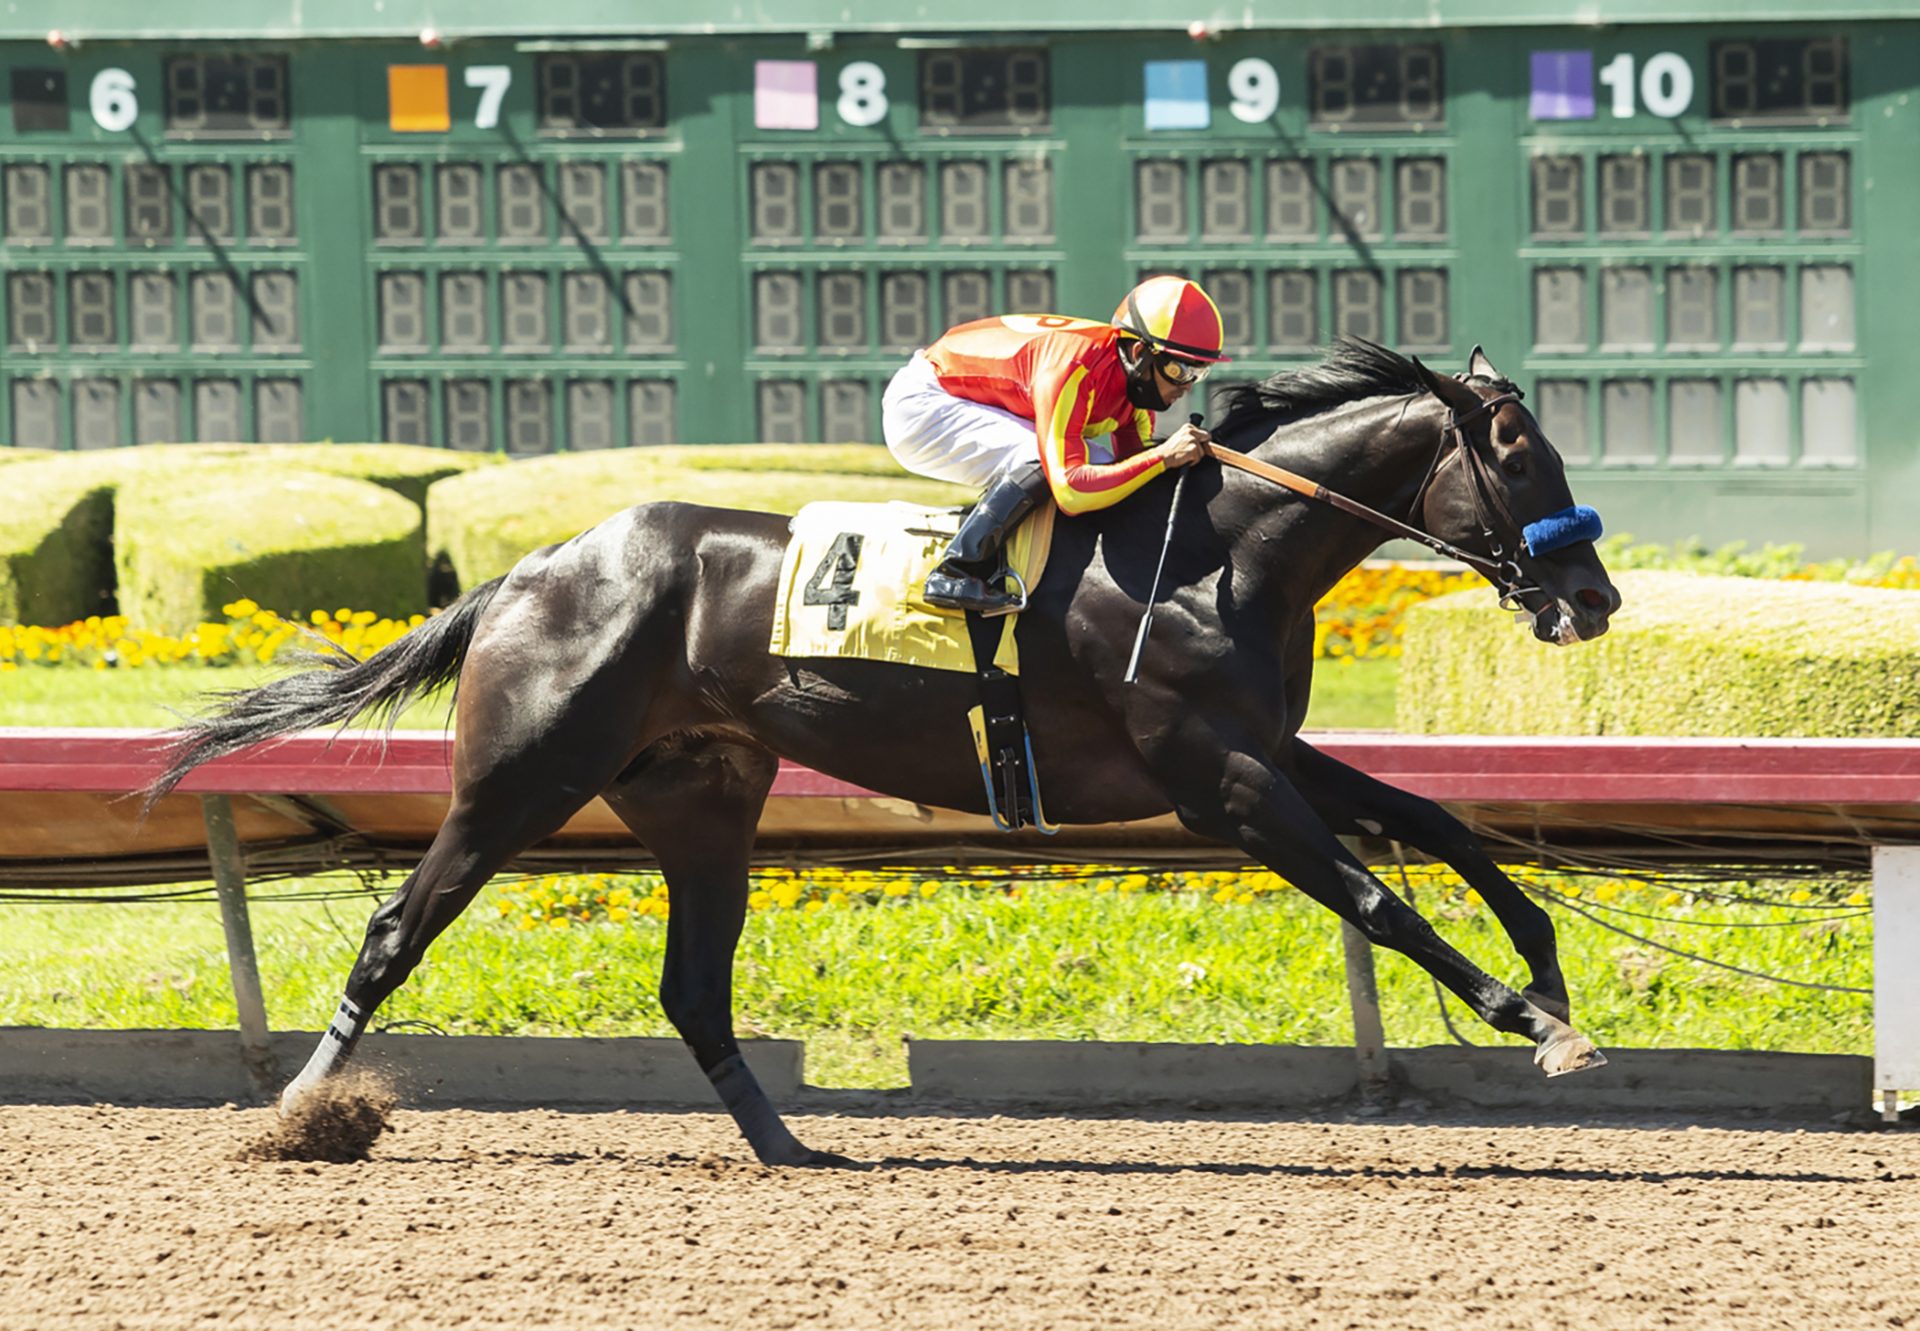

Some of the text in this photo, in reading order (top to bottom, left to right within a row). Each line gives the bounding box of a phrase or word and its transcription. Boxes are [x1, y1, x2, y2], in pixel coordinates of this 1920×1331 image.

[90, 68, 138, 132] 6
[465, 66, 511, 129] 7
[837, 62, 888, 127] 8
[1229, 59, 1279, 124] 9
[1600, 53, 1693, 119] 10
[803, 532, 864, 631] 4
